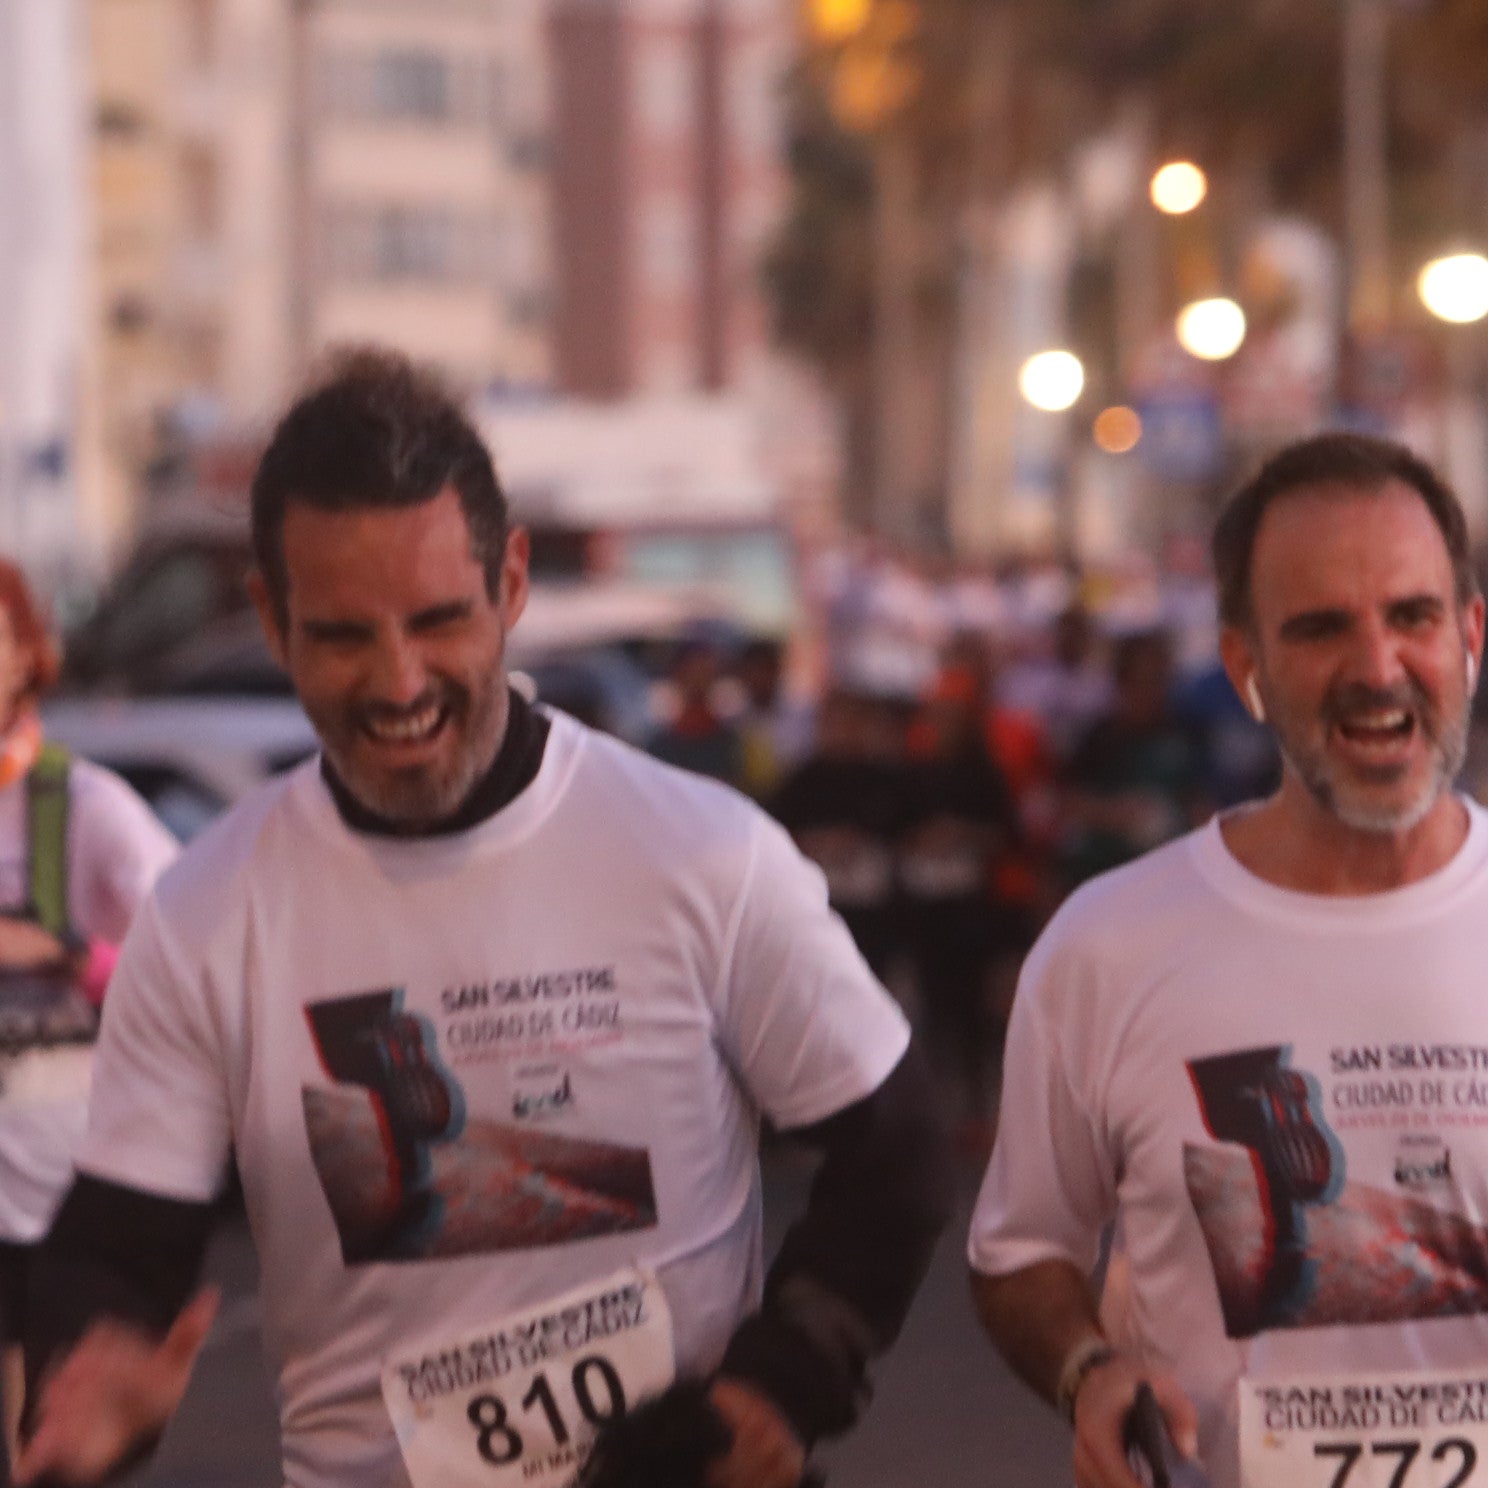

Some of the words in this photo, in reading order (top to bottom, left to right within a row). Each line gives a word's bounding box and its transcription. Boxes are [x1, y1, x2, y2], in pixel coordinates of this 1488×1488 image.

[441, 982, 489, 1012] SAN
[493, 965, 616, 1006] SILVESTRE
[446, 1013, 524, 1046] CIUDAD
[1330, 1045, 1382, 1073] SAN
[1332, 1080, 1414, 1108] CIUDAD
[1419, 1079, 1444, 1106] DE
[467, 1353, 628, 1467] 810
[1265, 1403, 1380, 1430] CIUDAD
[1391, 1402, 1426, 1427] DE
